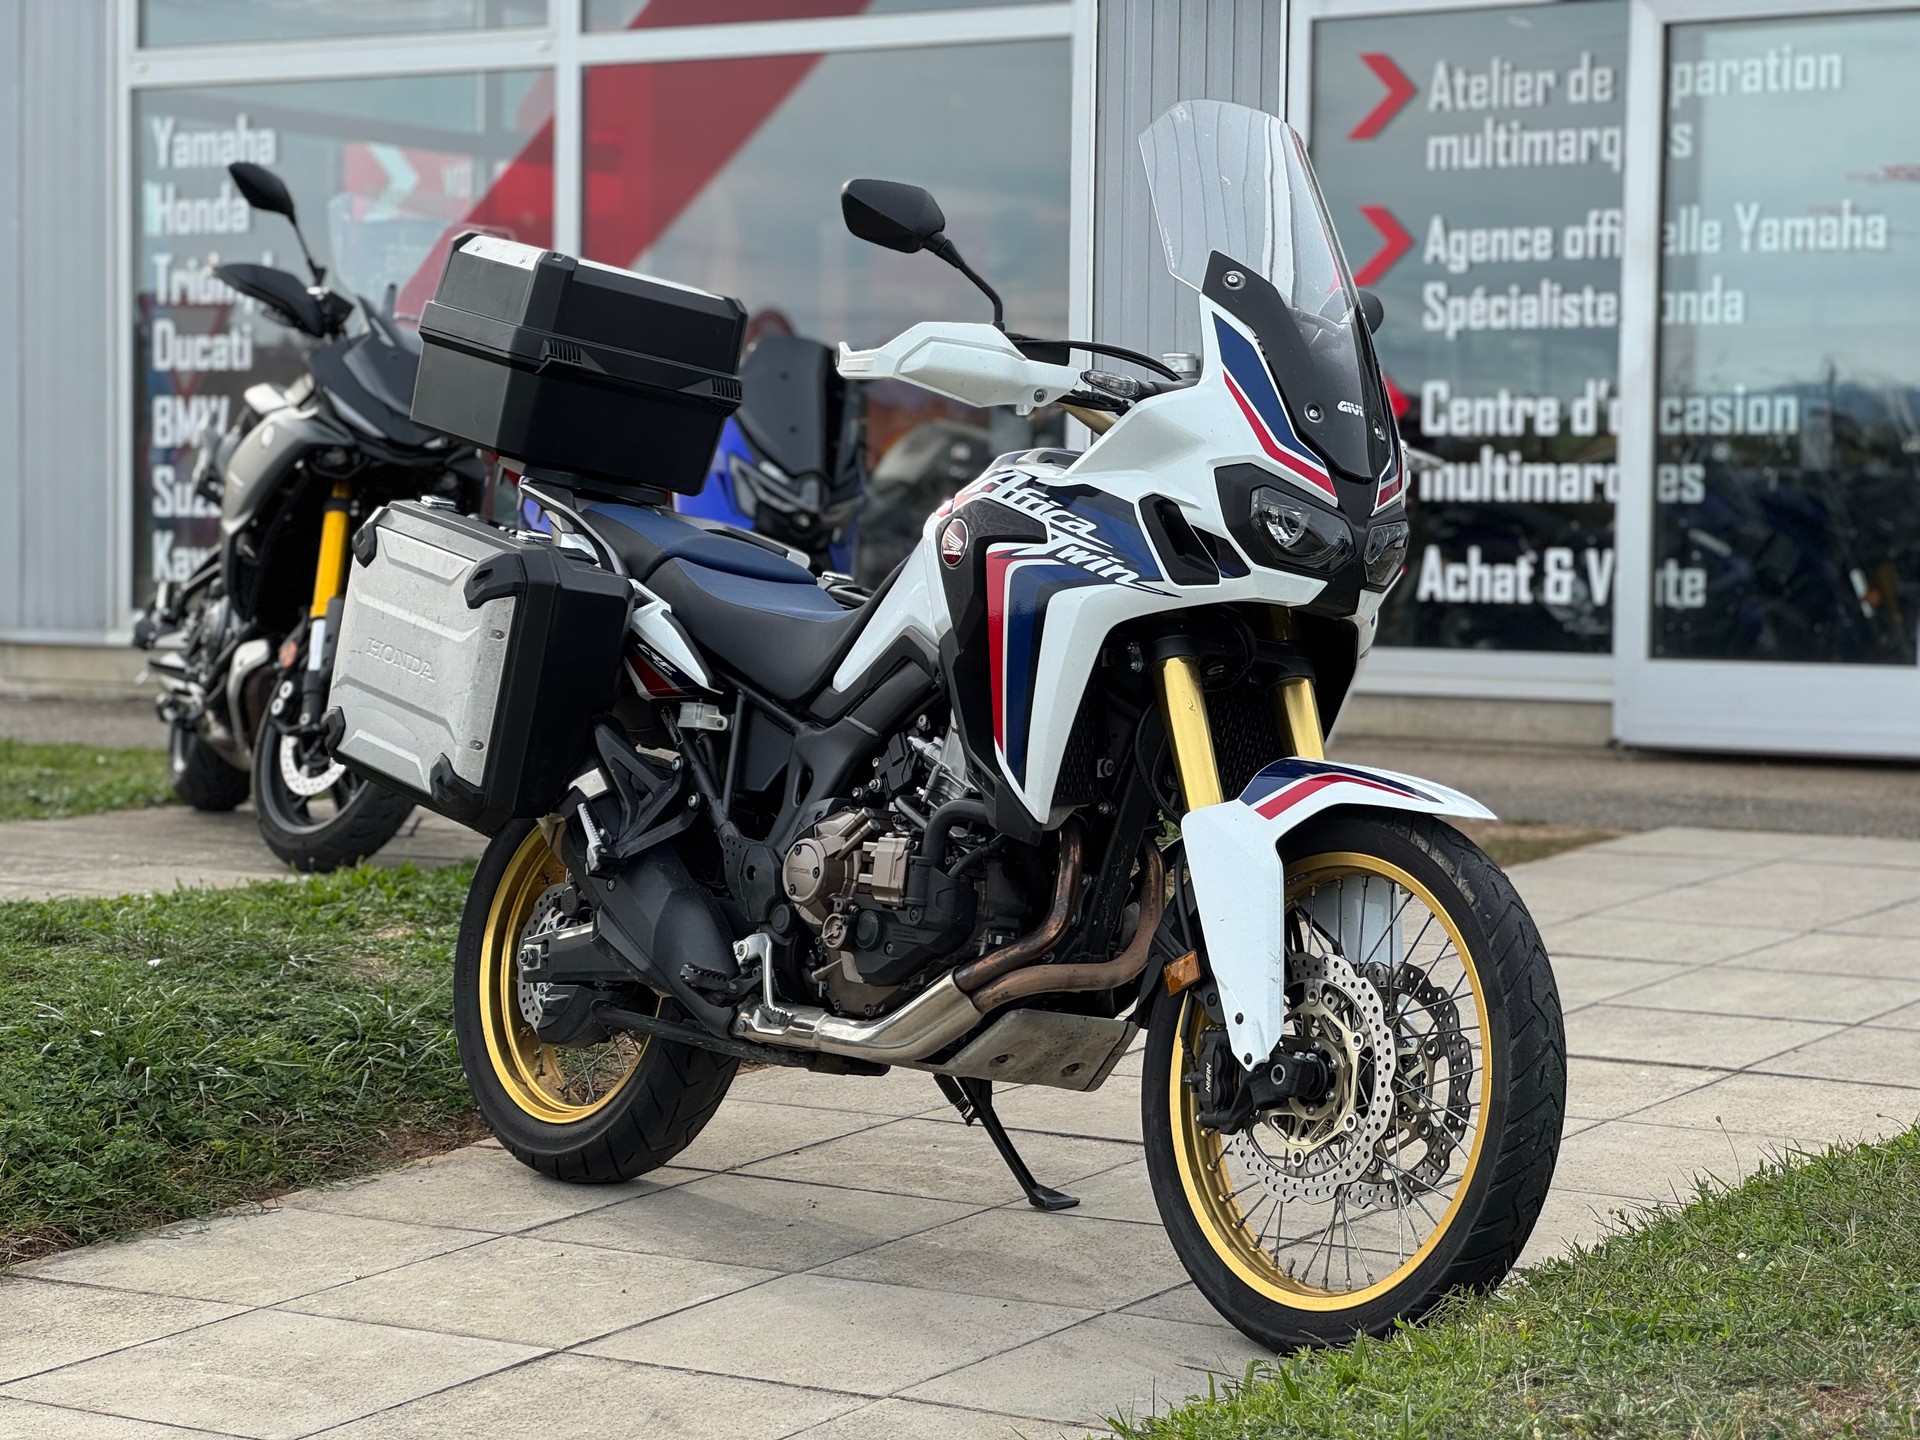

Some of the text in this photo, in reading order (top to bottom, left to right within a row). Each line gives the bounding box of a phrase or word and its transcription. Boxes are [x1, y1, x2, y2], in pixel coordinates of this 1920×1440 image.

[1427, 45, 1843, 112] Atelier de paration
[151, 113, 277, 169] Yamaha
[1426, 117, 1693, 173] multimarqs
[151, 181, 250, 236] Honda
[1423, 199, 1888, 274] Agence offielle Yamaha
[1422, 278, 1618, 341] Spécialiste
[152, 318, 253, 371] Ducati
[1337, 400, 1364, 418] GIVI
[1420, 379, 1562, 437] Centre
[1011, 528, 1167, 595] Twin
[1416, 546, 1534, 604] Achat
[1543, 548, 1575, 606] &
[366, 636, 436, 683] HONDA
